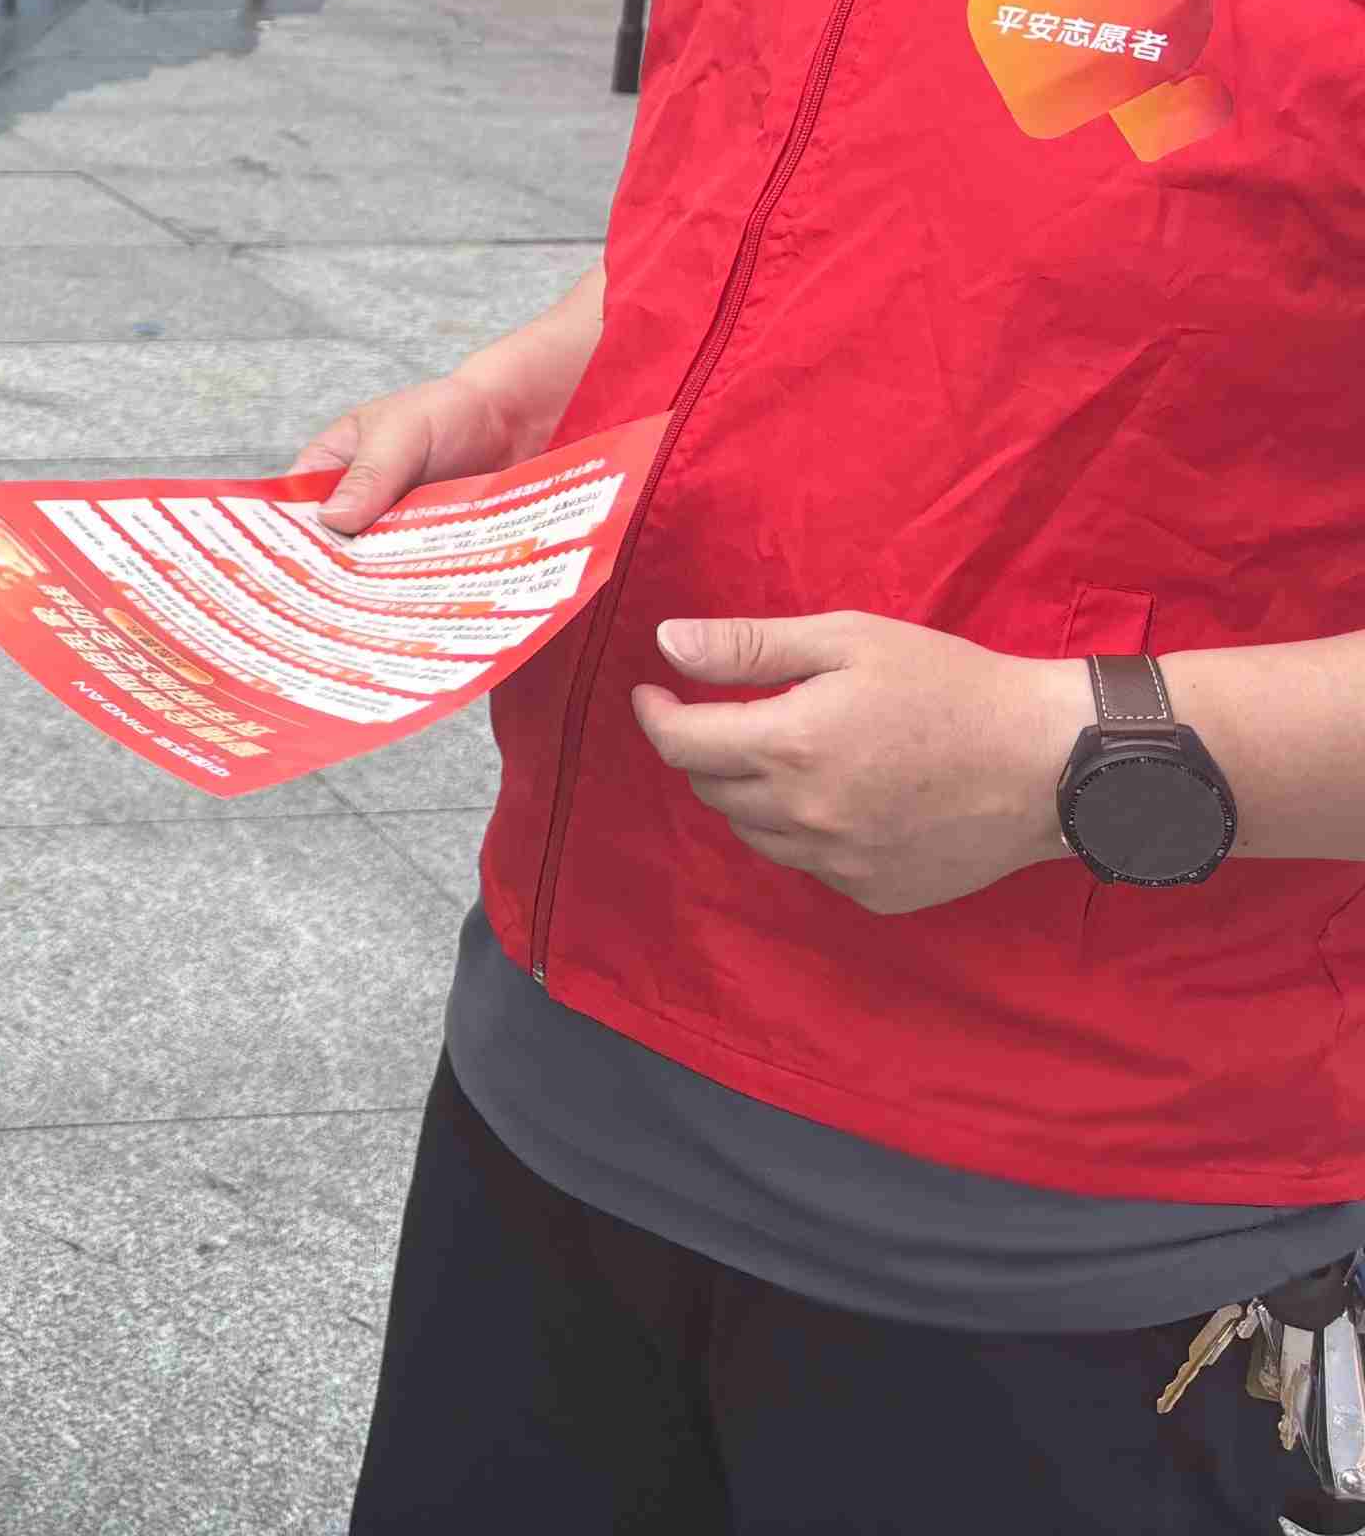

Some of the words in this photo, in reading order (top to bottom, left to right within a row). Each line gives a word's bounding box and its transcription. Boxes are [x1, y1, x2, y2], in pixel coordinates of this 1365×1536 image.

[991, 5, 1170, 63] 平安志愿者
